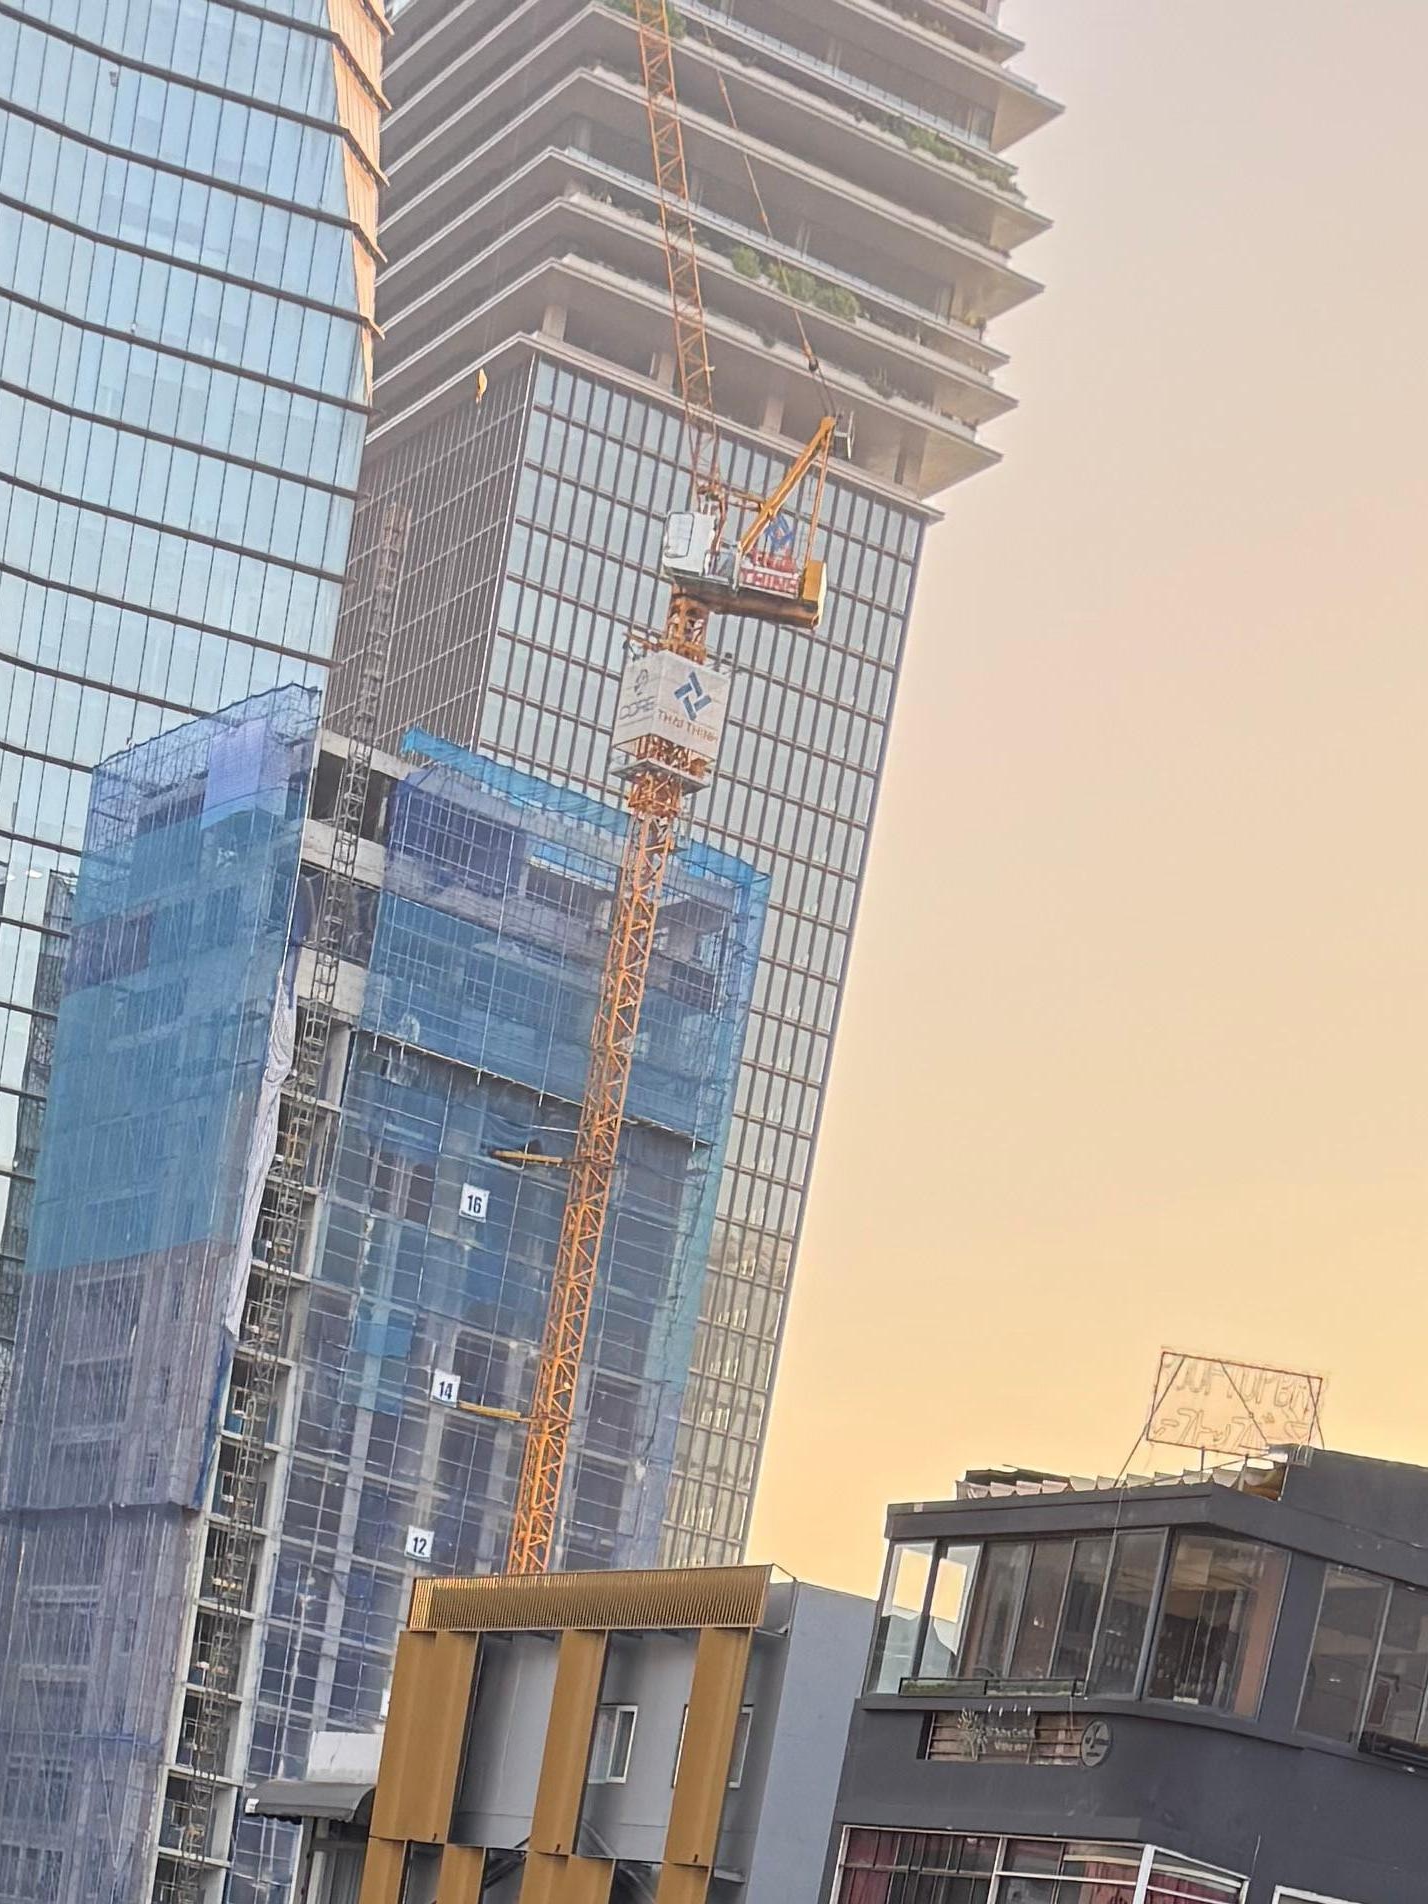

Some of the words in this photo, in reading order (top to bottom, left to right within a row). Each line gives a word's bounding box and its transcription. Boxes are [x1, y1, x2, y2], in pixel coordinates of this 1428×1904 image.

[467, 1193, 482, 1215] 16
[438, 1380, 453, 1401] 14
[413, 1535, 427, 1555] 12
